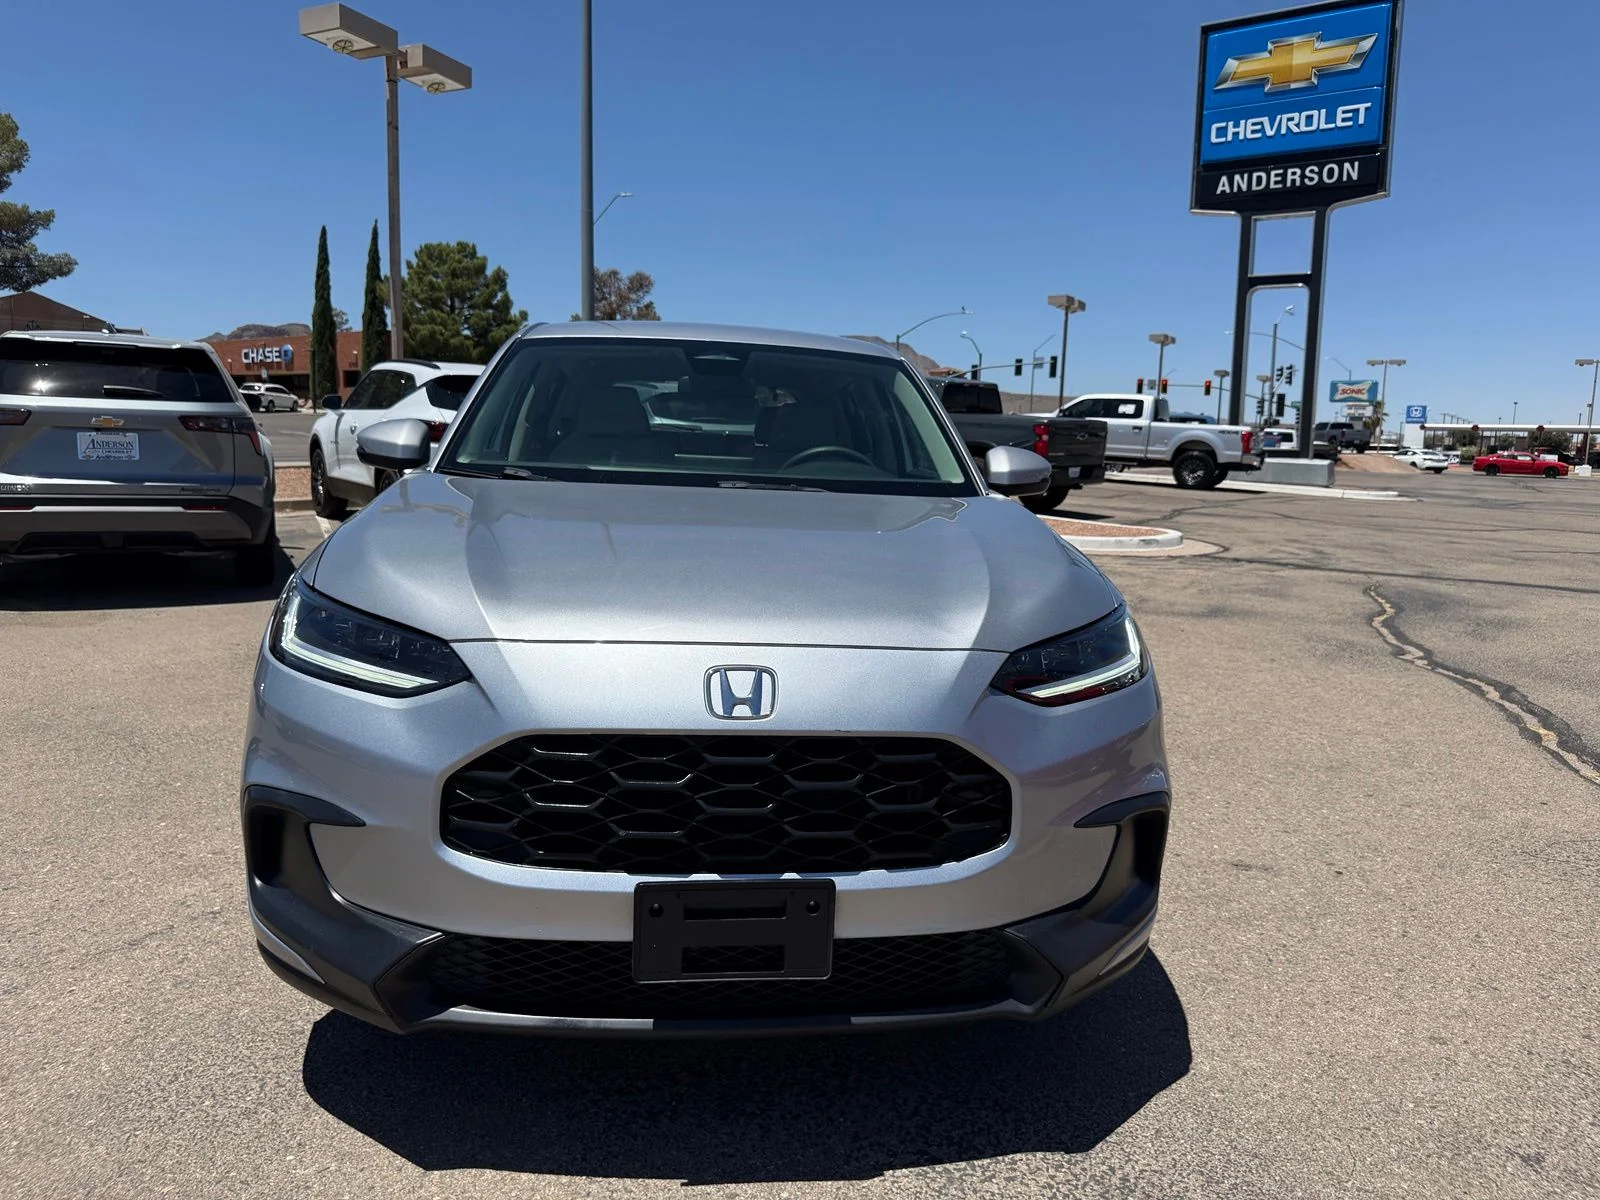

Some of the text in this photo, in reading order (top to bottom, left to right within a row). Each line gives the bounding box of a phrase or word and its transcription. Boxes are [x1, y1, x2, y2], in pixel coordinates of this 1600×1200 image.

[1210, 102, 1372, 144] CHEVROLET
[1215, 161, 1360, 195] ANDERSON
[241, 347, 282, 363] CHASE
[1339, 387, 1367, 396] SONIC
[83, 438, 135, 453] ANDERSON
